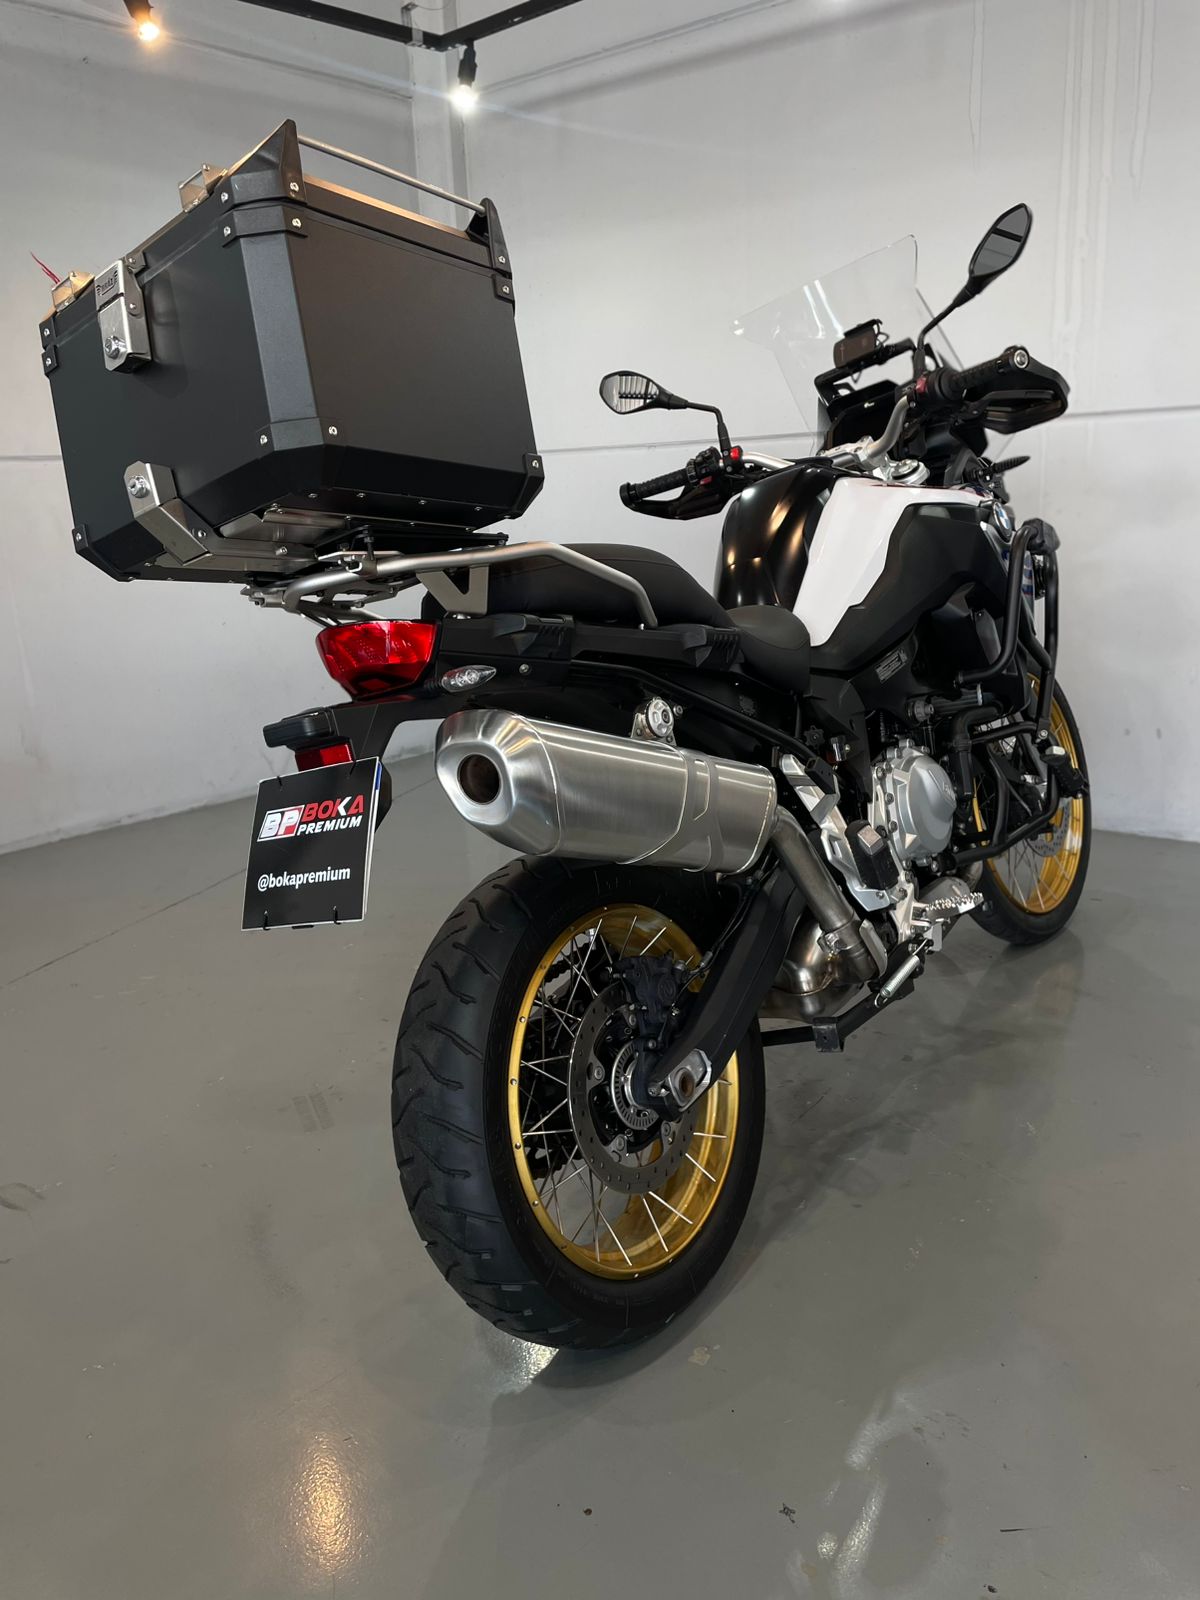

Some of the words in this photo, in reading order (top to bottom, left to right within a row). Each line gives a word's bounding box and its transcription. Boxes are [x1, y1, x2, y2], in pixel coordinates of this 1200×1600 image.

[301, 795, 364, 822] BOKA
[260, 809, 300, 838] BP
[297, 815, 362, 836] PREMIUM
[257, 866, 351, 892] @bokapremium
